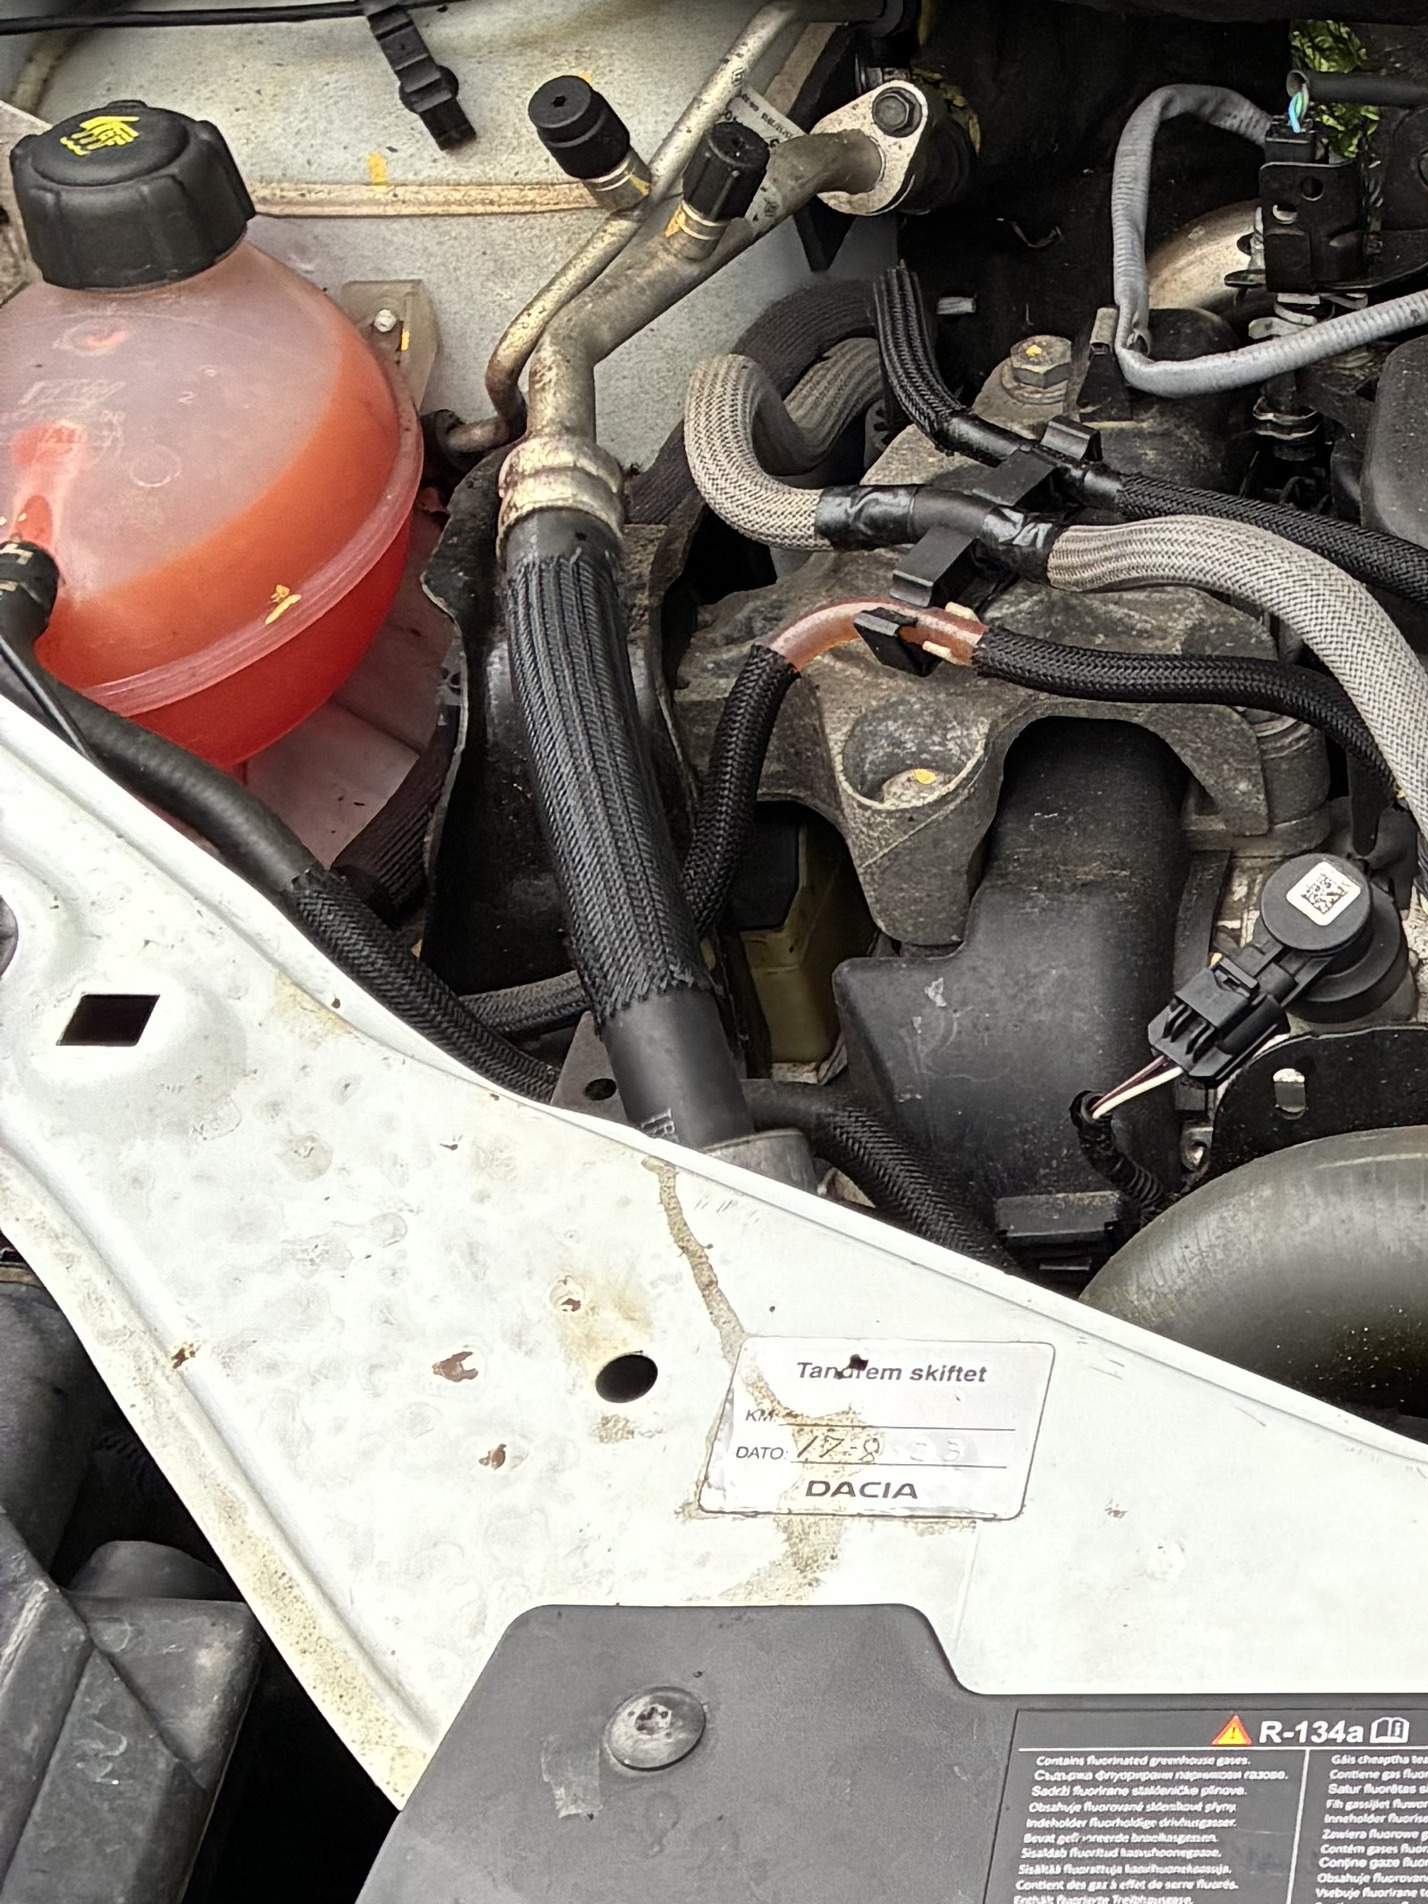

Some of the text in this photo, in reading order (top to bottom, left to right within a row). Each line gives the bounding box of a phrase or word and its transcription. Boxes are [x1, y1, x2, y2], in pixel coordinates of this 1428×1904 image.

[909, 1365, 987, 1382] skiftet
[805, 1480, 919, 1499] DACIA
[1258, 1720, 1365, 1745] R-134a
[1036, 1756, 1084, 1766] Contains
